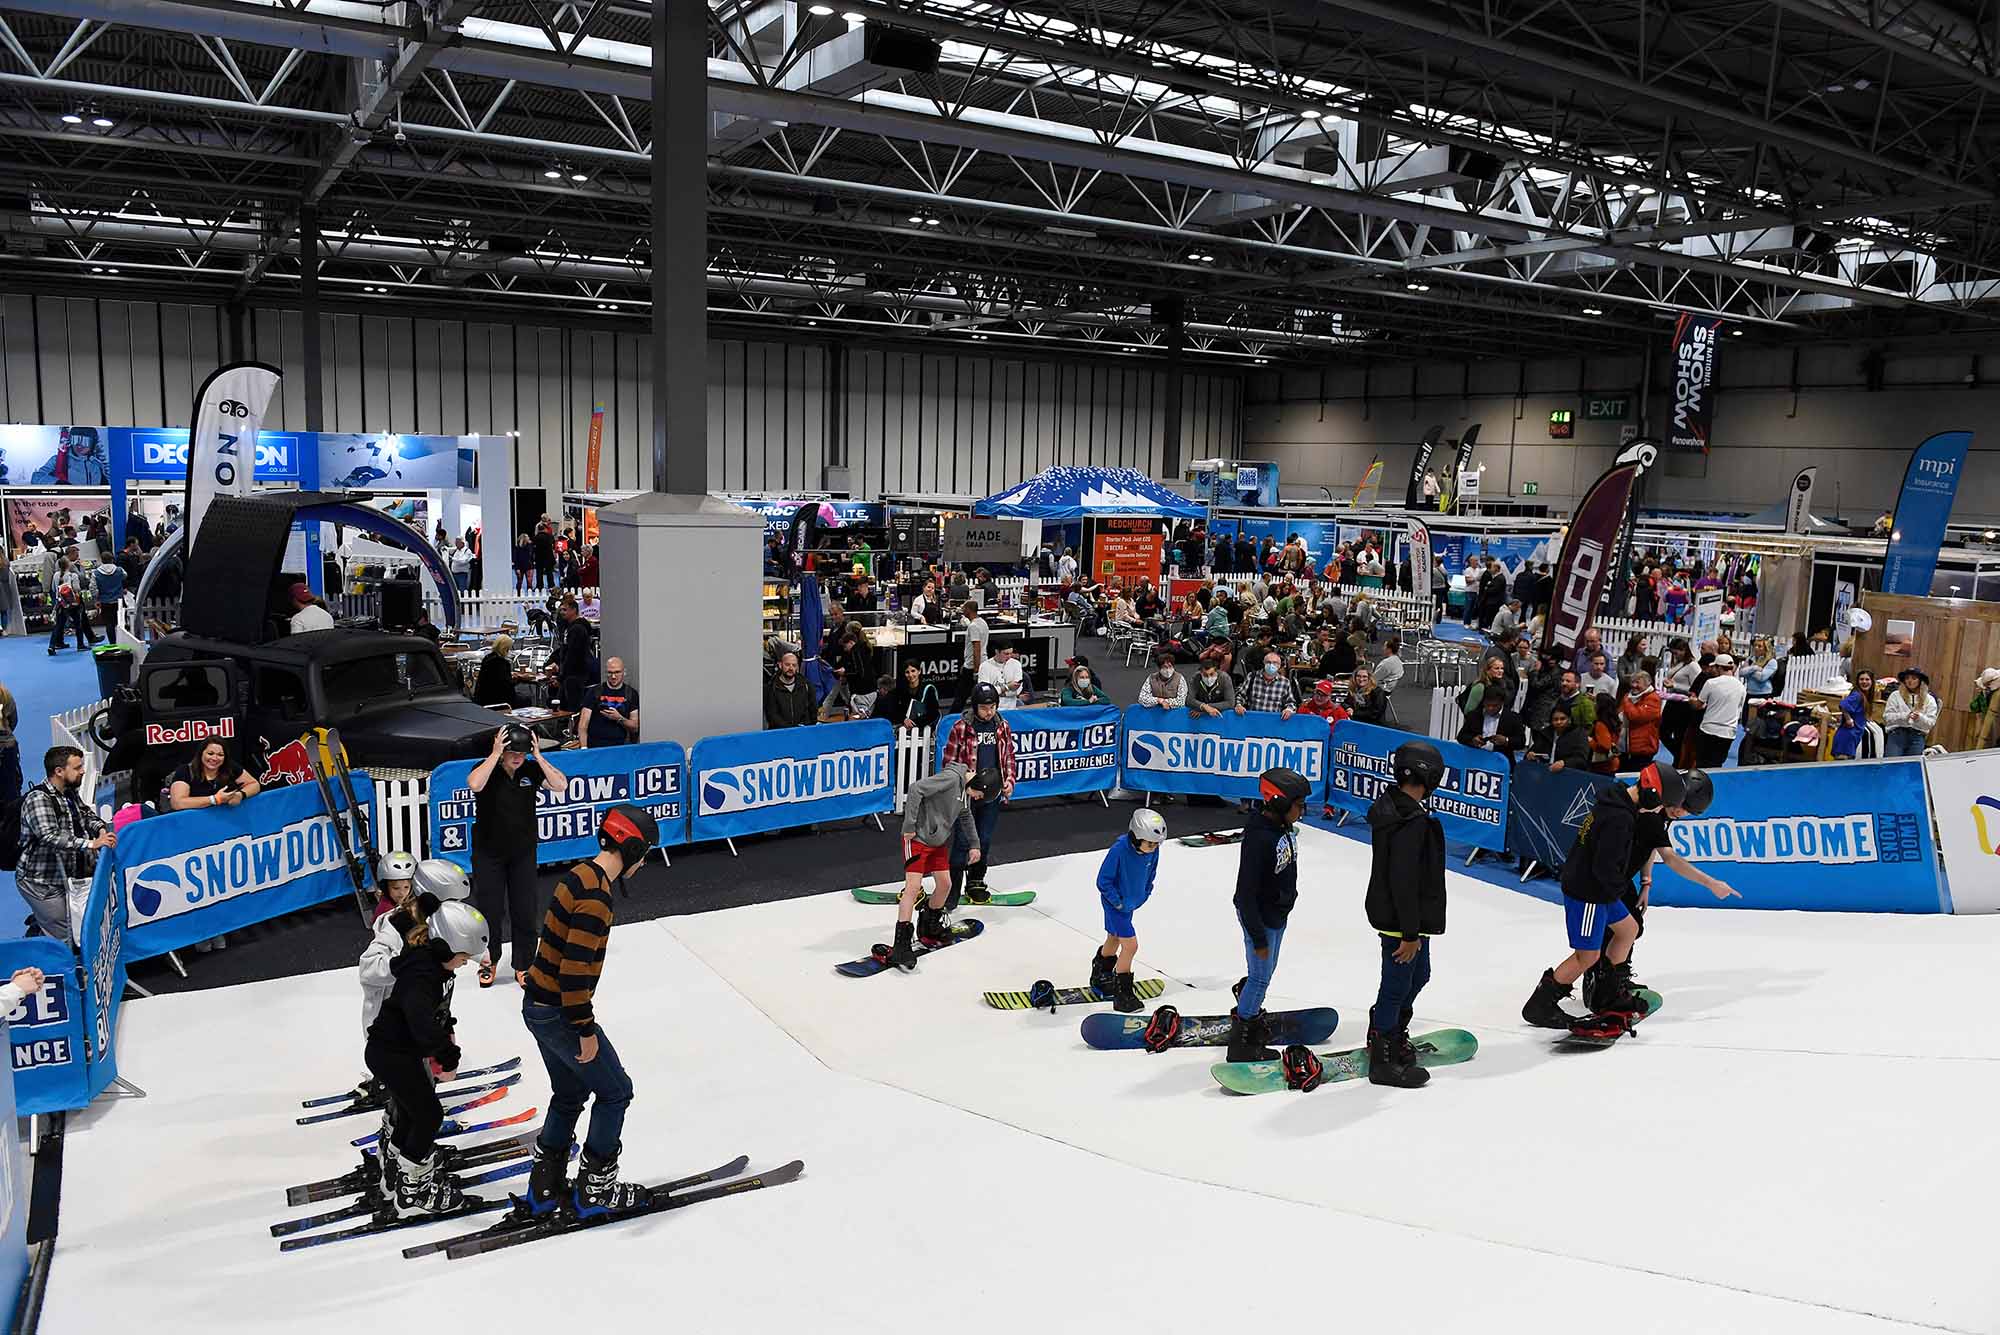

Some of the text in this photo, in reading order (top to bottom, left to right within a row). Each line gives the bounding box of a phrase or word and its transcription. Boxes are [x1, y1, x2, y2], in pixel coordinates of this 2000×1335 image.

[1688, 326, 1707, 412] SNOW
[1703, 347, 1714, 387] NATIONAL
[1674, 342, 1692, 429] SHOW
[1589, 400, 1625, 416] EXIT
[143, 443, 288, 466] DECON
[1672, 436, 1705, 447] #snowshow
[1919, 457, 1956, 478] mpi
[833, 509, 868, 520] LITE
[966, 531, 1000, 541] MADE
[147, 717, 234, 744] Red Bull
[1084, 725, 1115, 748] ICE
[1167, 736, 1318, 778] SNOWDOME
[1343, 743, 1358, 753] THE
[1053, 753, 1115, 771] EXPERIENCE
[1335, 750, 1387, 775] ULTIMATE
[638, 768, 677, 796] ICE
[742, 752, 885, 805] SNOWDOME
[1335, 770, 1347, 788] &
[1467, 770, 1500, 798] ICE
[1432, 796, 1499, 823] EXPERIENCE
[443, 826, 463, 848] &
[1673, 821, 1873, 858] SNOWDOME
[1882, 815, 1899, 861] SNOW
[1899, 814, 1919, 861] DOME
